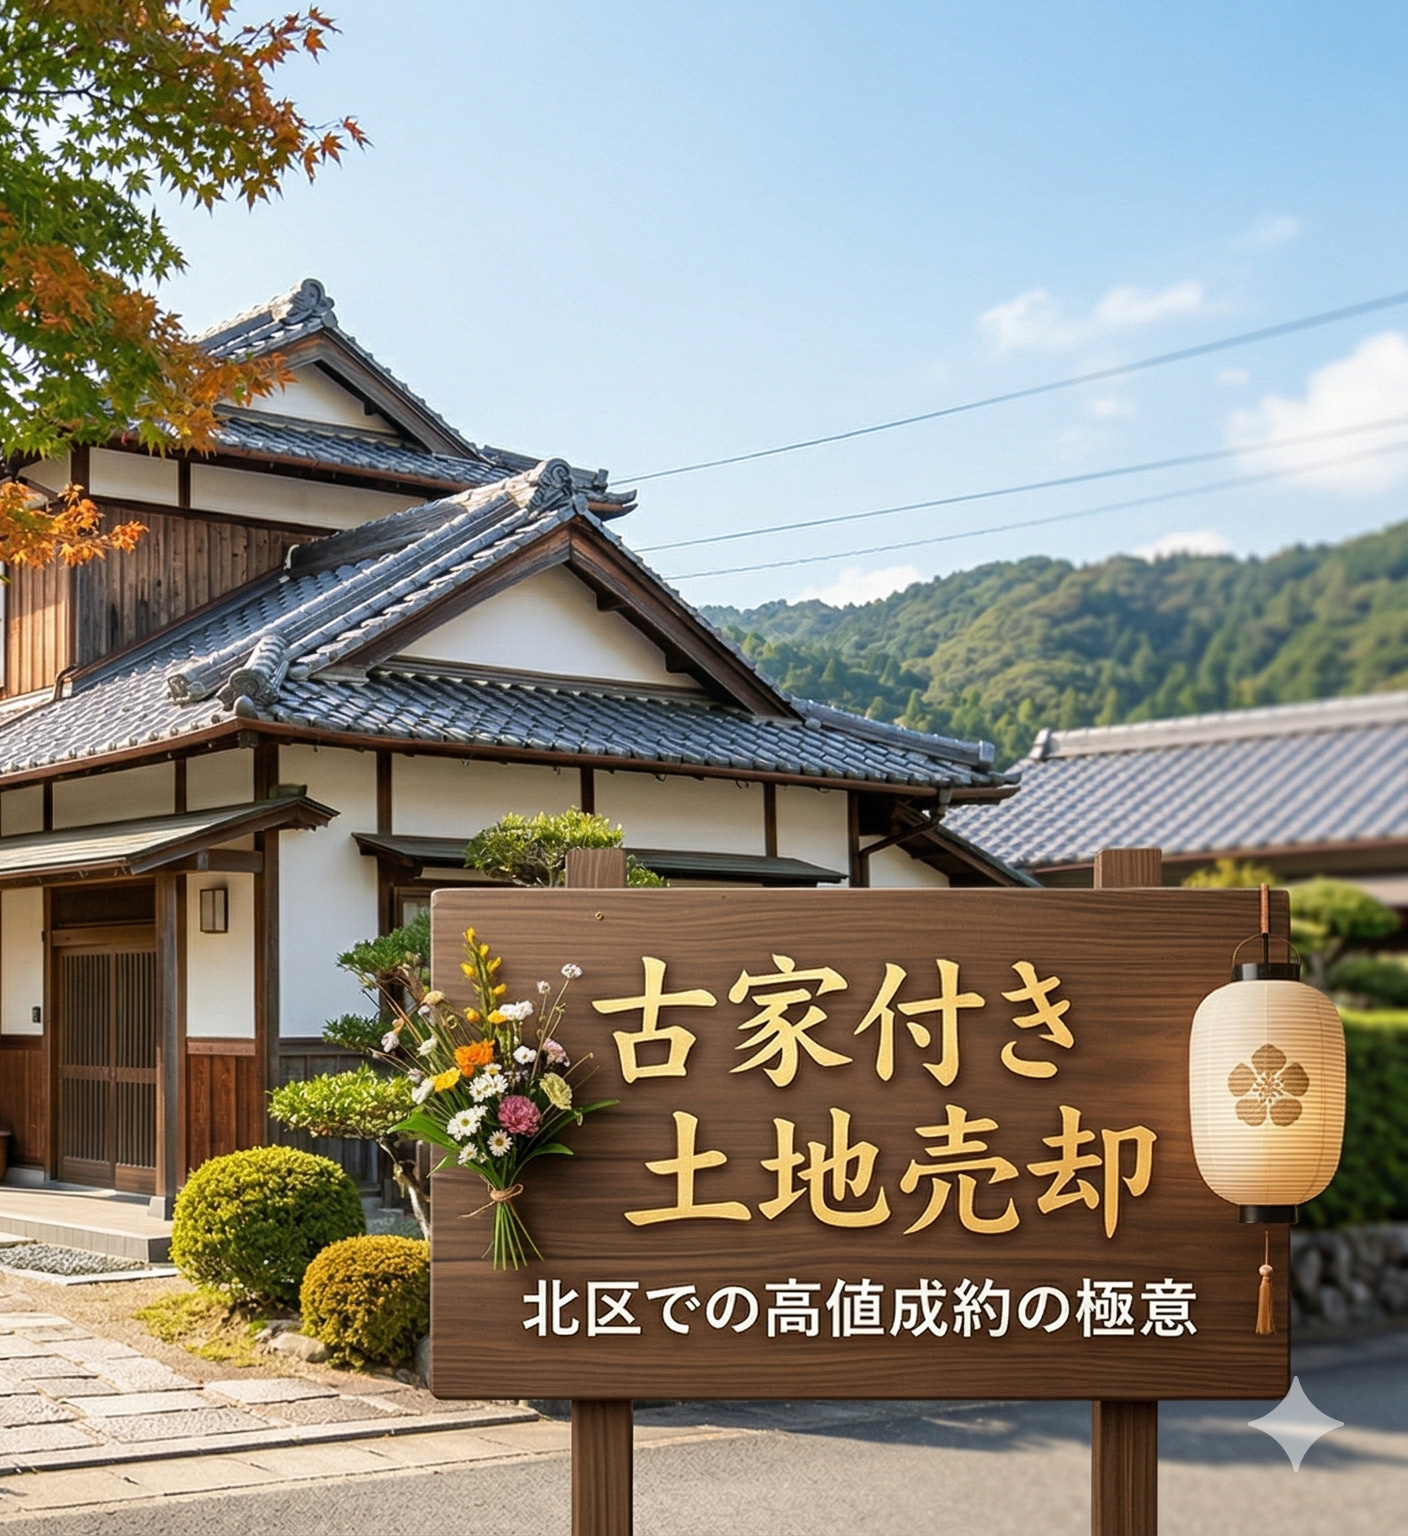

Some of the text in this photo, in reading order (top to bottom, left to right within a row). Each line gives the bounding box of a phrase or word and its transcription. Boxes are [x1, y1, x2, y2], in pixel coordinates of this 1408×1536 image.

[592, 955, 1075, 1087] 古家付き
[623, 1104, 1157, 1239] 土地売却
[522, 1278, 1197, 1338] 北区での高値成約の極意
